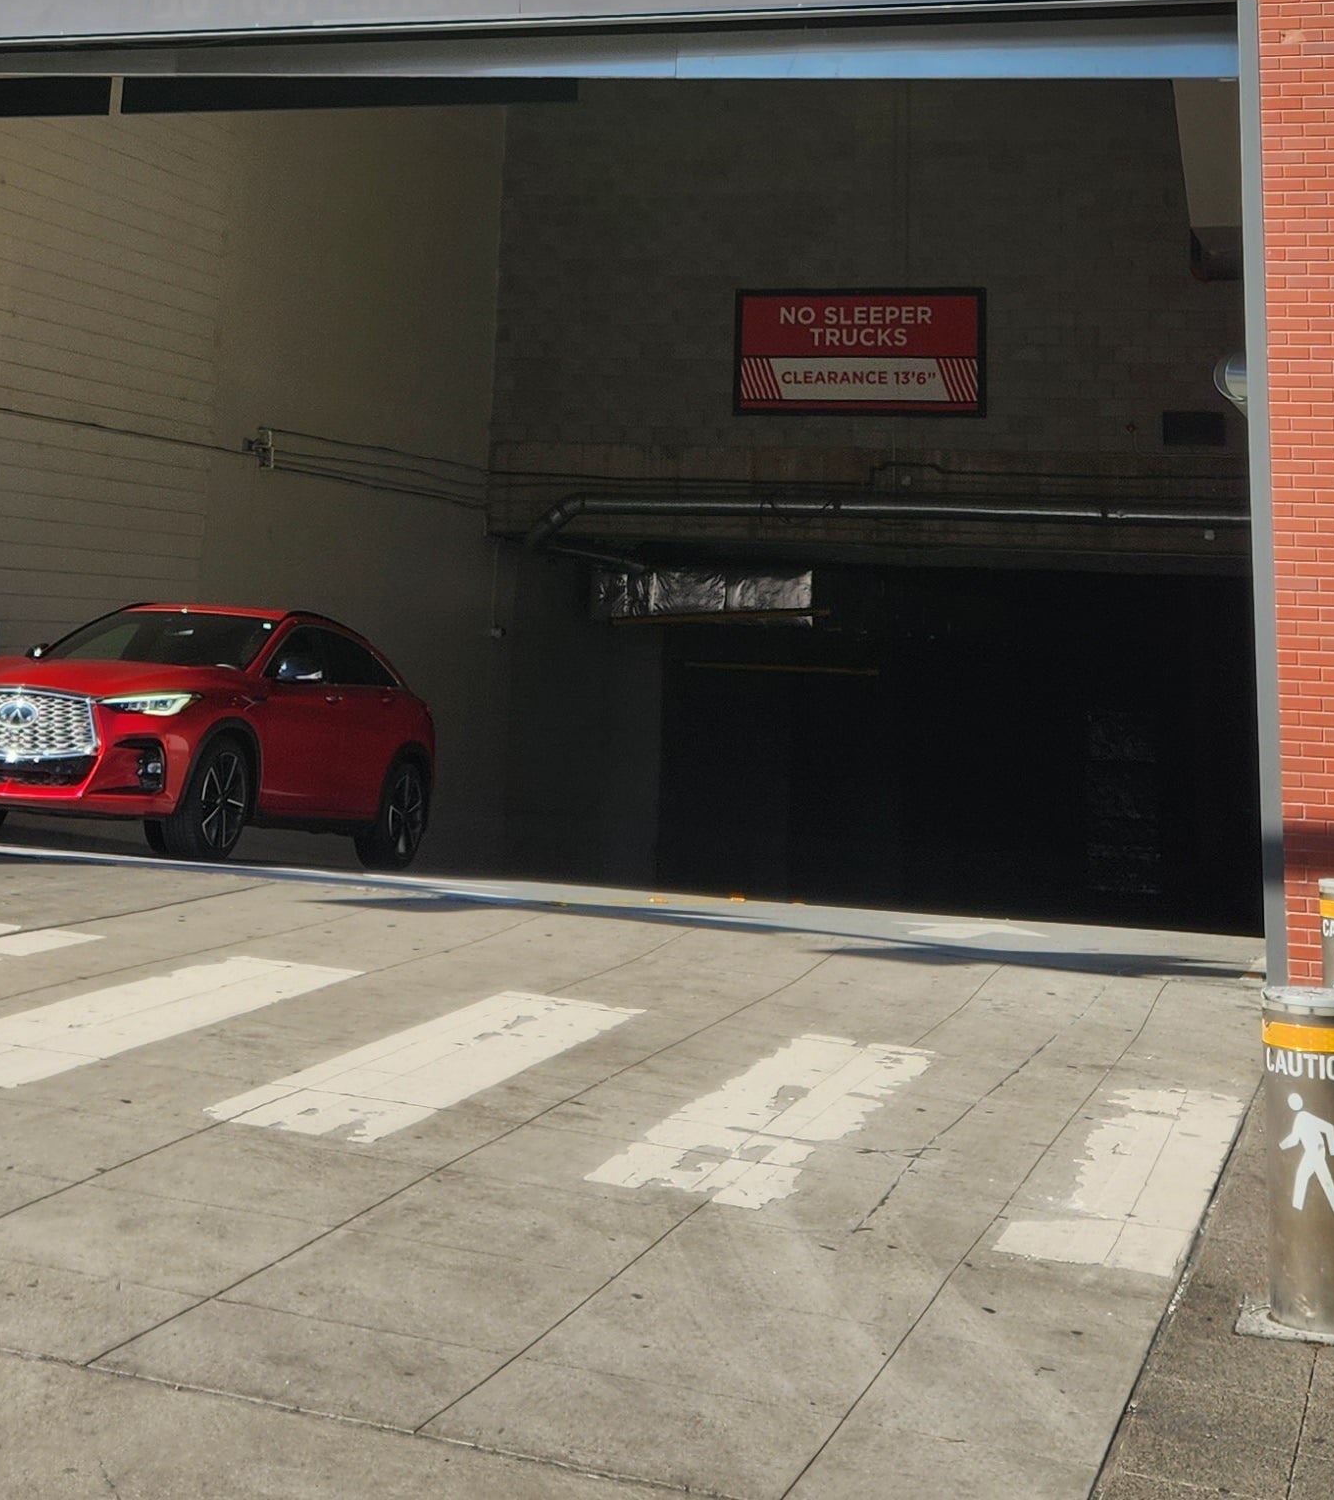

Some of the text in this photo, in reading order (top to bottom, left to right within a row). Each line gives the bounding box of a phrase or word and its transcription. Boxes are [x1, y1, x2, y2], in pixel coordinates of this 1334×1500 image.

[779, 306, 932, 325] NO SLEEPER
[810, 328, 908, 347] TRUCKS
[781, 371, 888, 385] CLEARANCE
